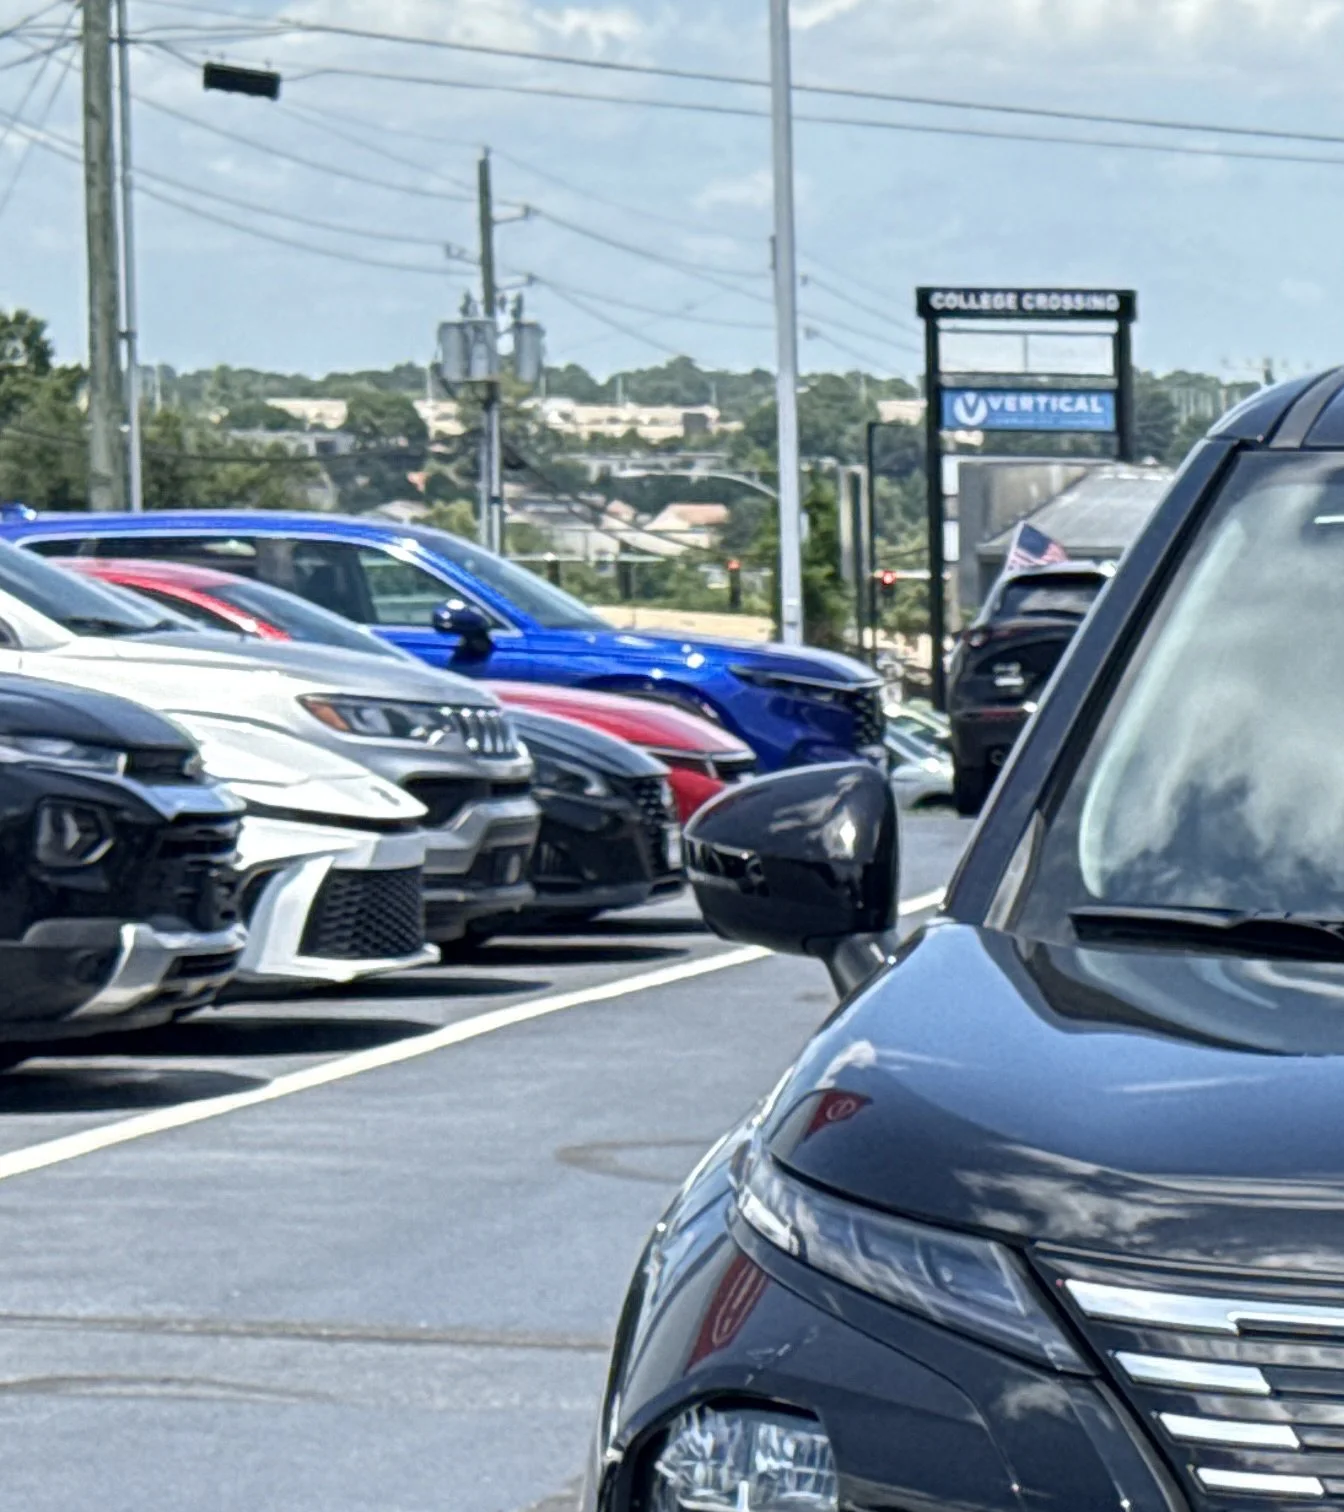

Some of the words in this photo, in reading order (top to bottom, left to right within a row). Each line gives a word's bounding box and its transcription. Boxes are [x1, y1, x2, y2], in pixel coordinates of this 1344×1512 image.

[929, 291, 1018, 311] COLLEGE
[1022, 292, 1120, 312] CROSSING
[988, 394, 1104, 413] VERTICAL
